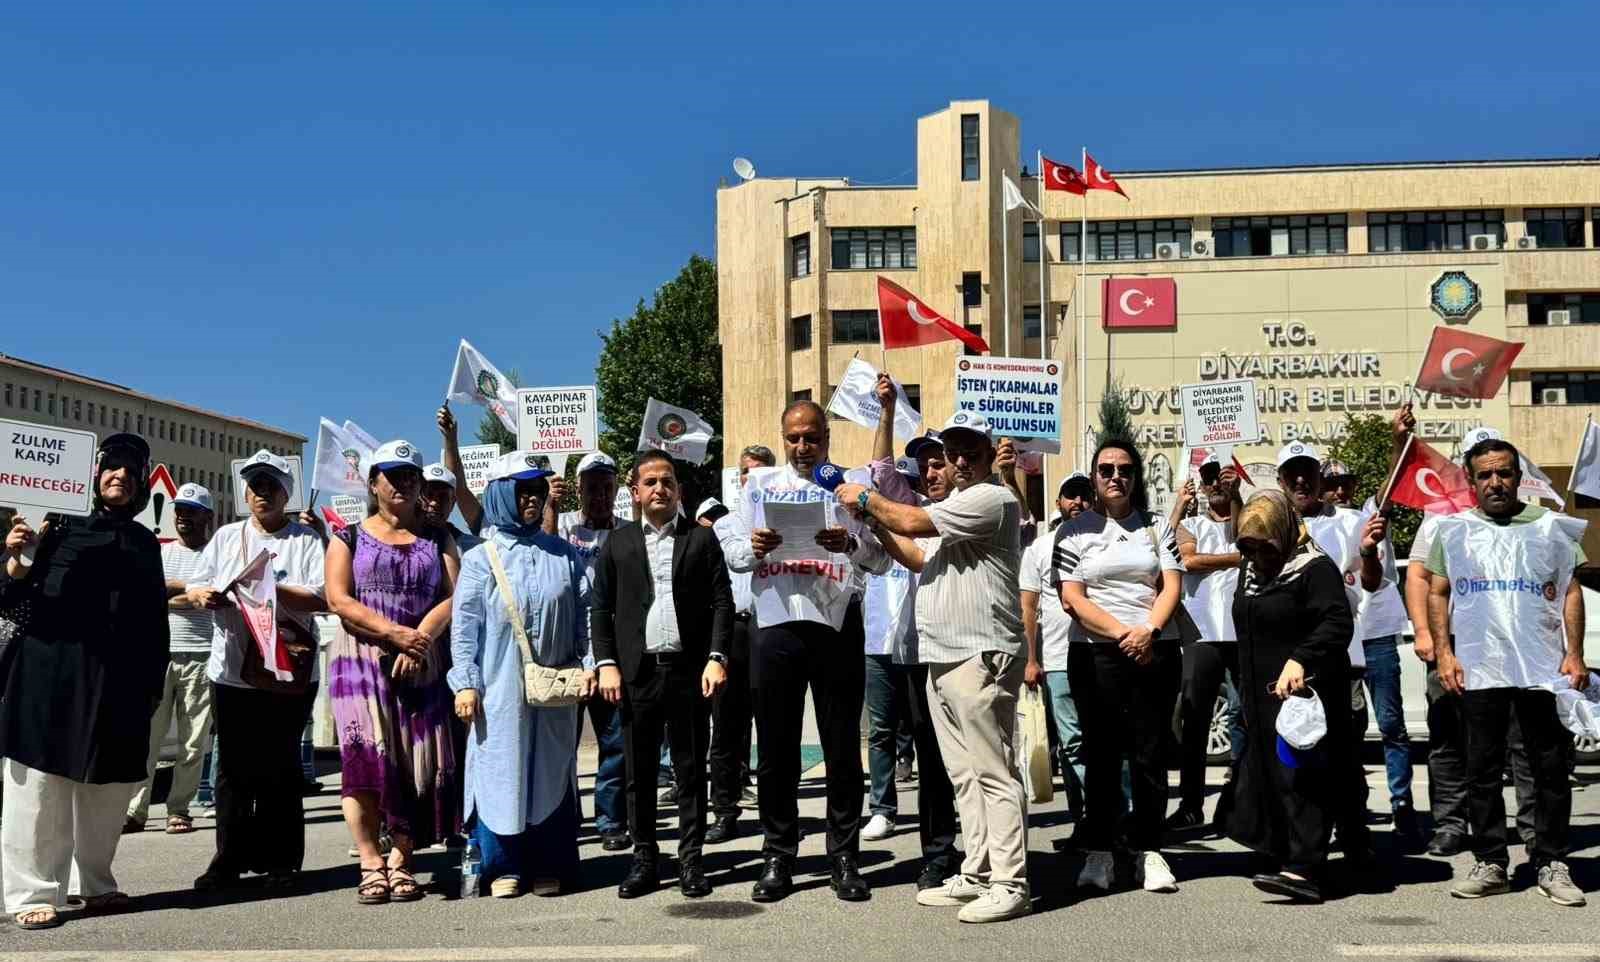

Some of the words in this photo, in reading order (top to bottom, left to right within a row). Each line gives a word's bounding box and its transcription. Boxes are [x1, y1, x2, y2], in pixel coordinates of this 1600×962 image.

[1263, 322, 1317, 347] T.C.
[1199, 350, 1381, 379] DİYARBAKIR
[957, 374, 987, 394] İŞTEN
[989, 379, 1058, 395] ÇIKARMALAR
[525, 392, 586, 404] KAYAPINAR
[1193, 386, 1242, 398] DİYARBAKIR
[961, 401, 975, 411] ve
[978, 395, 1055, 415] SÜRGÜNLER
[1192, 394, 1244, 407] BÜYÜKŞEHİR
[526, 402, 586, 415] BELEDİYESİ
[1197, 403, 1242, 416] BELEDİYESİ
[535, 414, 578, 429] İŞÇİLERİ
[1204, 412, 1237, 425] İŞÇİLERİ
[538, 427, 577, 438] YALNIZ
[1207, 423, 1236, 432] YALNIZ
[1280, 421, 1348, 446] BAJA
[11, 432, 67, 452] ZULME
[1203, 431, 1241, 442] DEĞİLDİR
[531, 438, 583, 450] DEĞİLDİR
[15, 447, 61, 466] KARŞI
[466, 471, 482, 480] LER
[0, 472, 86, 495] RENECEĞİZ
[470, 479, 485, 489] SIN
